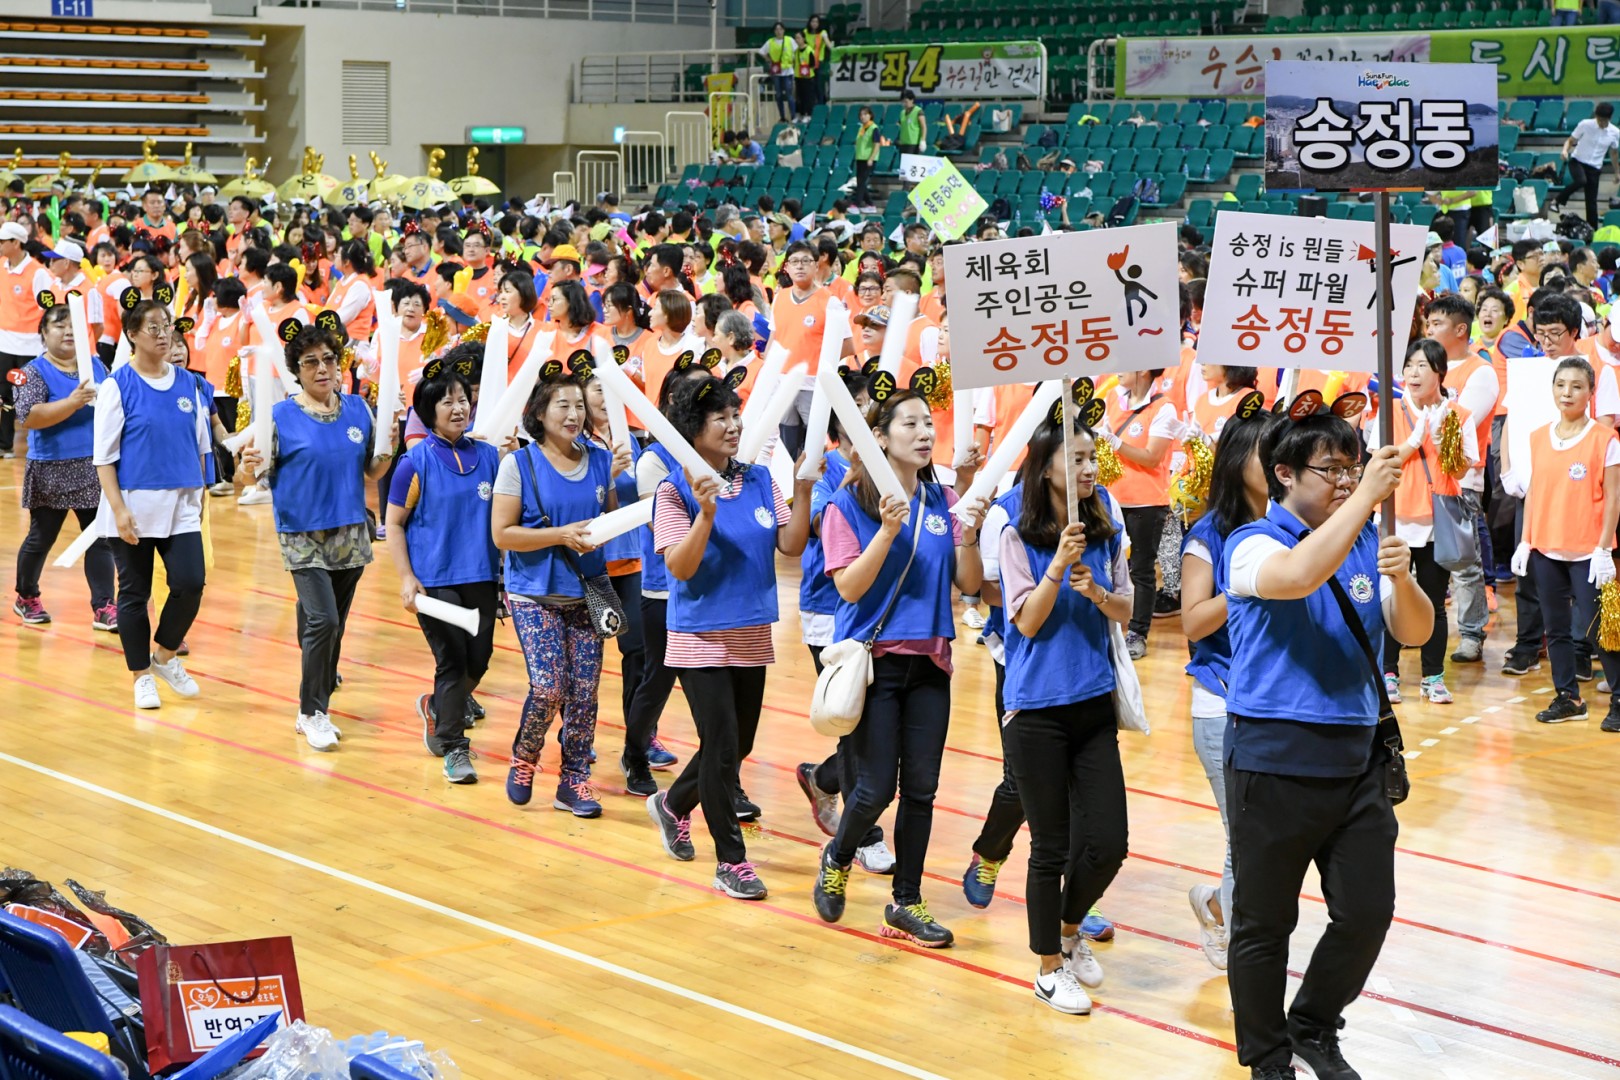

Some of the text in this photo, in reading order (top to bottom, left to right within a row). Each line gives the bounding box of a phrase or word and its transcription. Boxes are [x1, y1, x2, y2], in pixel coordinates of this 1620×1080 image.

[58, 0, 86, 16] 1-11
[836, 53, 878, 82] 최강
[1294, 98, 1473, 172] 송정동
[1229, 232, 1345, 263] 송정 is 뭔들
[965, 248, 1050, 282] 체육회
[126, 287, 170, 308] 송 정
[1232, 268, 1348, 304] 슈퍼 파월
[974, 280, 1092, 319] 주인공은
[285, 314, 336, 340] 송 정
[1231, 304, 1354, 356] 송정동
[983, 316, 1119, 372] 송정동
[10, 371, 26, 385] 강
[427, 361, 472, 378] 송 정
[874, 372, 933, 400] 송 정
[1076, 380, 1093, 405] 정
[1086, 401, 1104, 426] 정
[1242, 394, 1260, 418] 송
[1342, 400, 1367, 417] 강
[204, 1013, 269, 1039] 반여
